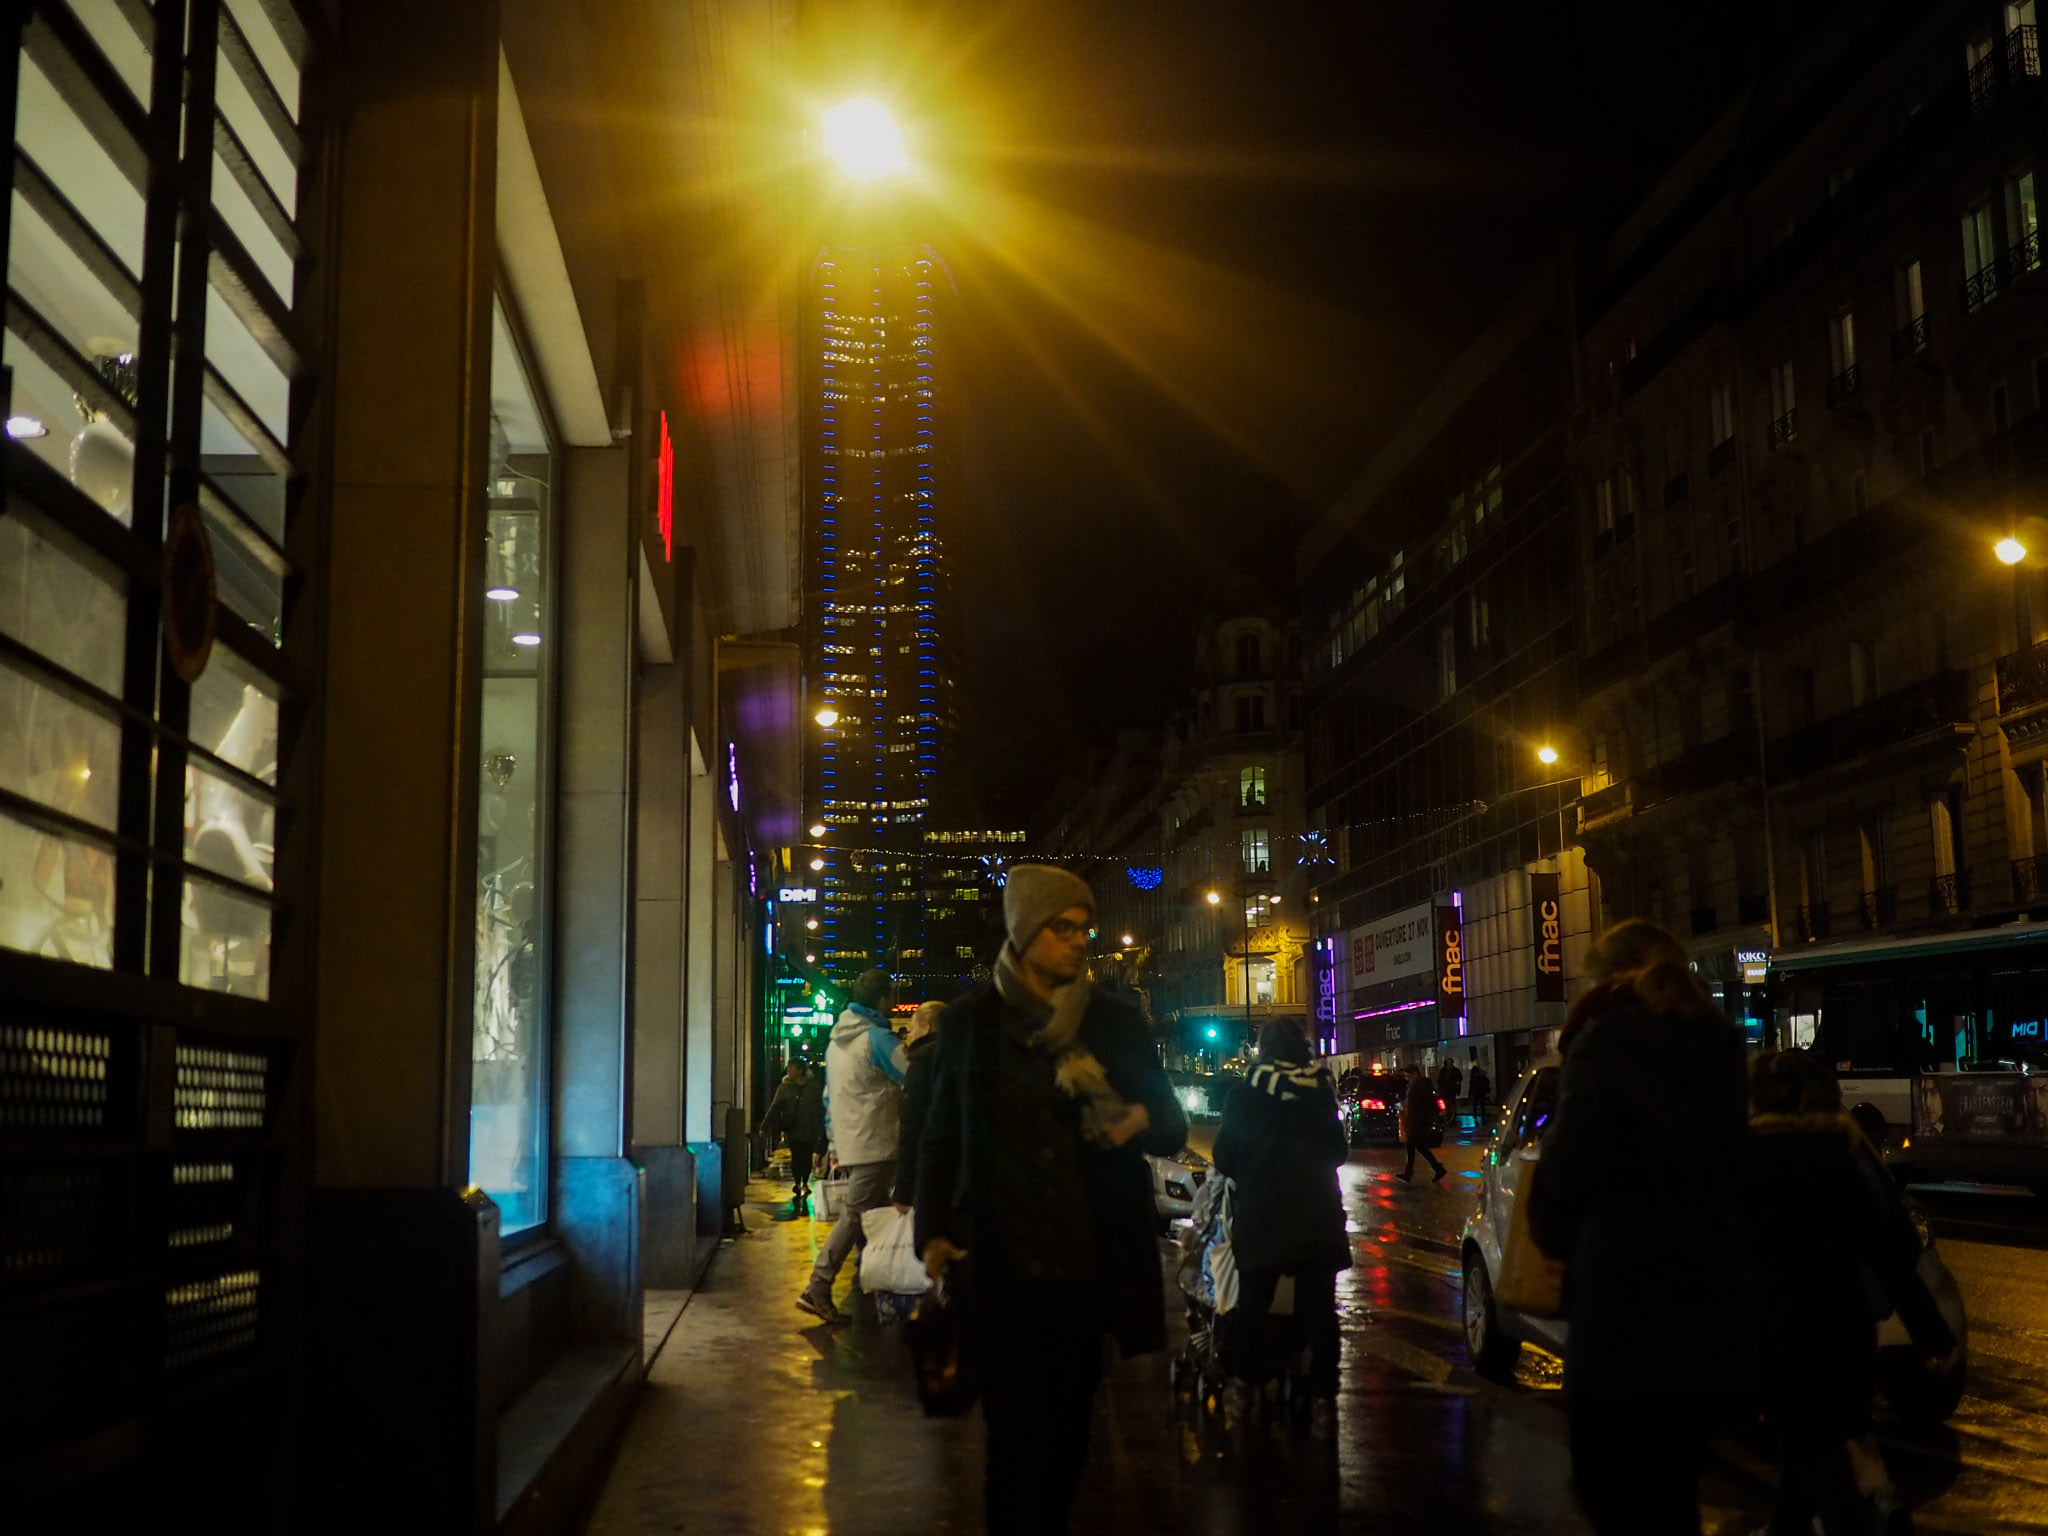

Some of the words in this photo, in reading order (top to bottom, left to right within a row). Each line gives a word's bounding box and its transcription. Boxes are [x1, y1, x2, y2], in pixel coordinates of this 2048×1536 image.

[1375, 924, 1407, 951] OUVERTURE
[1408, 921, 1415, 941] 27
[1537, 900, 1561, 975] fnac
[1738, 952, 1766, 961] KIKO
[1441, 929, 1463, 995] fnac
[1316, 969, 1332, 1022] fnac
[1385, 1023, 1401, 1041] fnac
